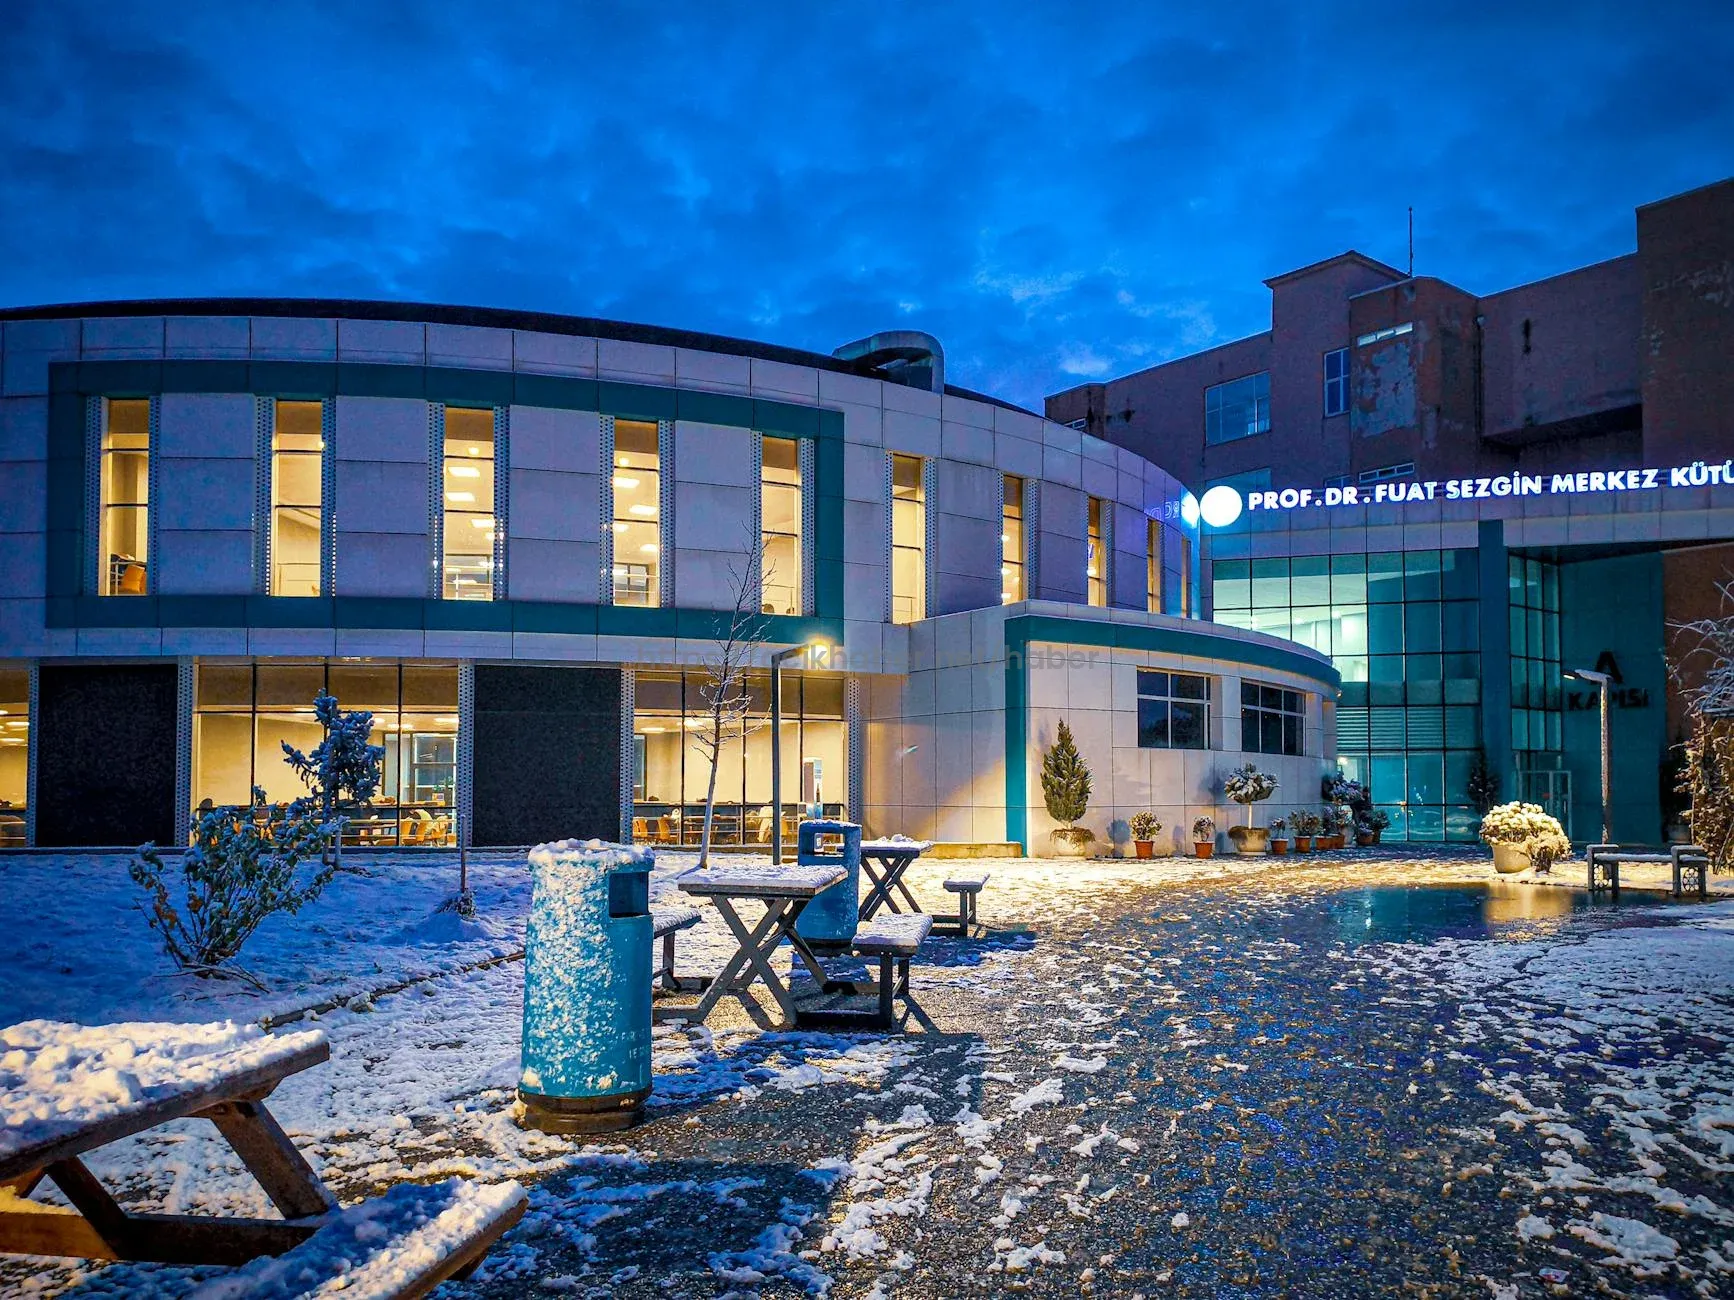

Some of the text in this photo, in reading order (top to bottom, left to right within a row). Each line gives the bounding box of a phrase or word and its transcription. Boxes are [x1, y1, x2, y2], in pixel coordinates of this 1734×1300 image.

[1375, 478, 1438, 503] FUAT
[1445, 470, 1542, 499] SEZGİN
[1550, 468, 1659, 494] MERKEZ
